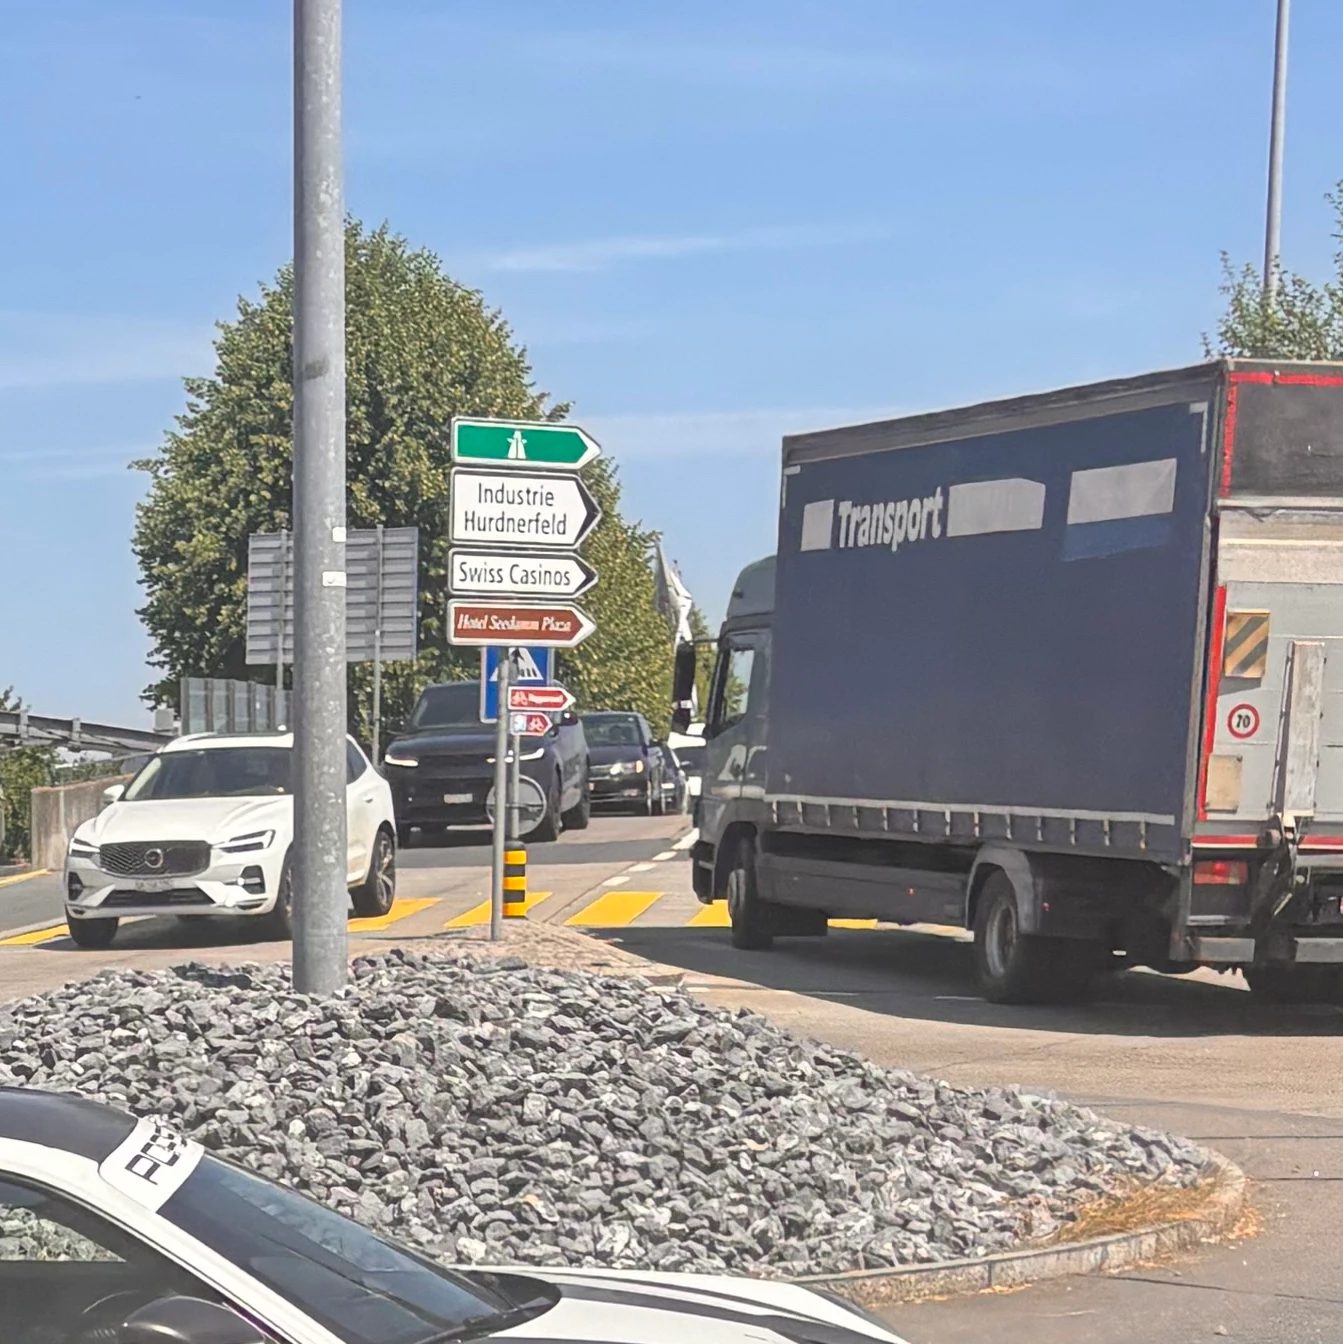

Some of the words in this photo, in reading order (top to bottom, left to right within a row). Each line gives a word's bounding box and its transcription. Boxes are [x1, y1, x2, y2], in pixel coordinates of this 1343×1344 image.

[478, 482, 554, 507] Industrie
[464, 510, 567, 535] Hurdnerfeld
[839, 486, 943, 552] Transport
[459, 561, 504, 584] Swiss
[509, 564, 571, 586] Casinos
[457, 613, 487, 630] Hotel
[1237, 714, 1251, 728] 70
